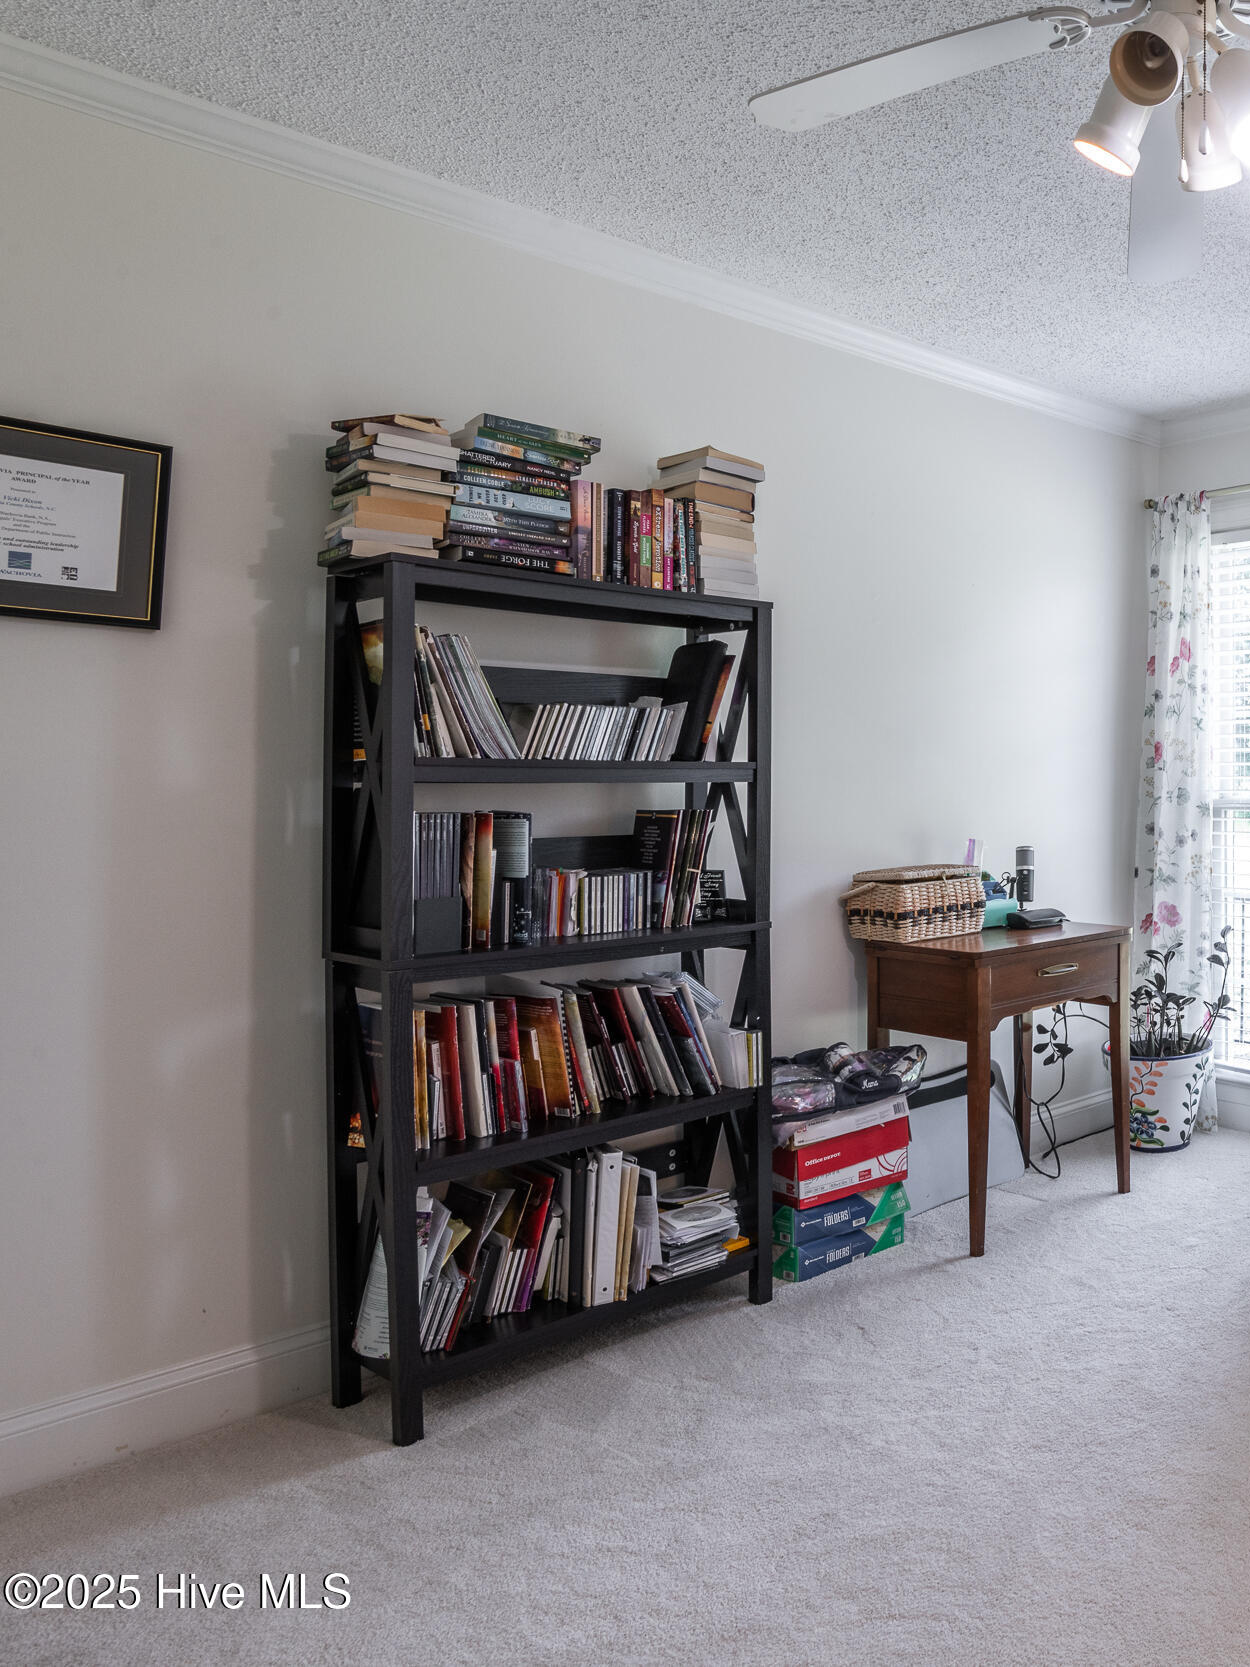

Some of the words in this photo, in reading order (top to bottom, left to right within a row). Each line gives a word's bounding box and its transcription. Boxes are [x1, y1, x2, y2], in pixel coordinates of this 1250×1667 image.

[16, 470, 53, 480] PRINCIPAL
[527, 466, 543, 474] NANCY
[463, 475, 487, 486] COLLEEN
[488, 478, 505, 488] COBLE
[529, 486, 555, 496] AMBUSH
[501, 554, 530, 566] FORGE
[532, 559, 550, 569] THE
[804, 1157, 823, 1167] Office
[823, 1151, 841, 1161] DEPOT
[824, 1209, 849, 1227] FOLDERS
[826, 1246, 850, 1264] FOLDERS
